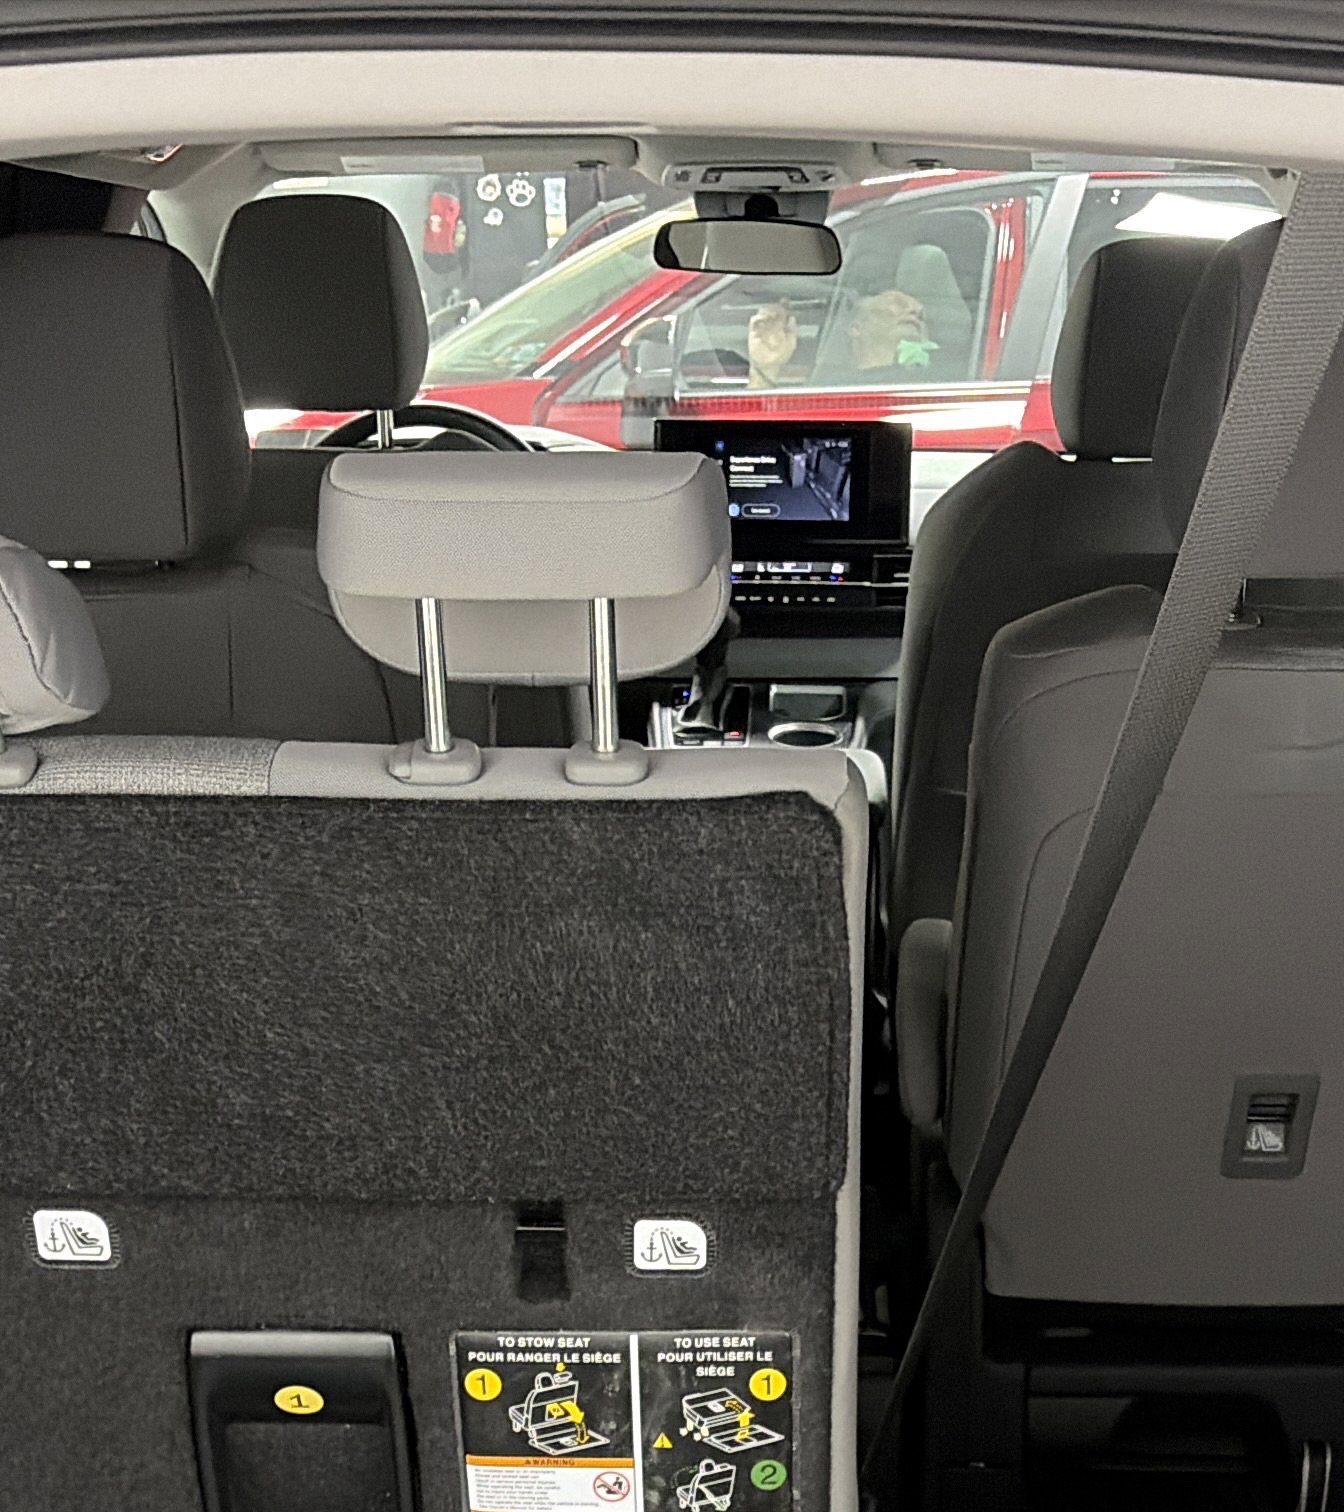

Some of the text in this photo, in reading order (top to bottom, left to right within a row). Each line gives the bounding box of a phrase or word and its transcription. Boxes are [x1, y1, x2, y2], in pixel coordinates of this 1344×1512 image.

[497, 1337, 591, 1348] TO STOW SEAT
[674, 1336, 756, 1349] TO USE SEAT
[468, 1351, 622, 1364] POUR RANGER LE SIÈGE
[657, 1351, 773, 1363] POUR UTILISER LE
[696, 1364, 735, 1377] SIÈGE
[475, 1374, 487, 1396] 1
[761, 1374, 771, 1396] 1
[289, 1393, 310, 1409] 1
[760, 1464, 777, 1485] 2
